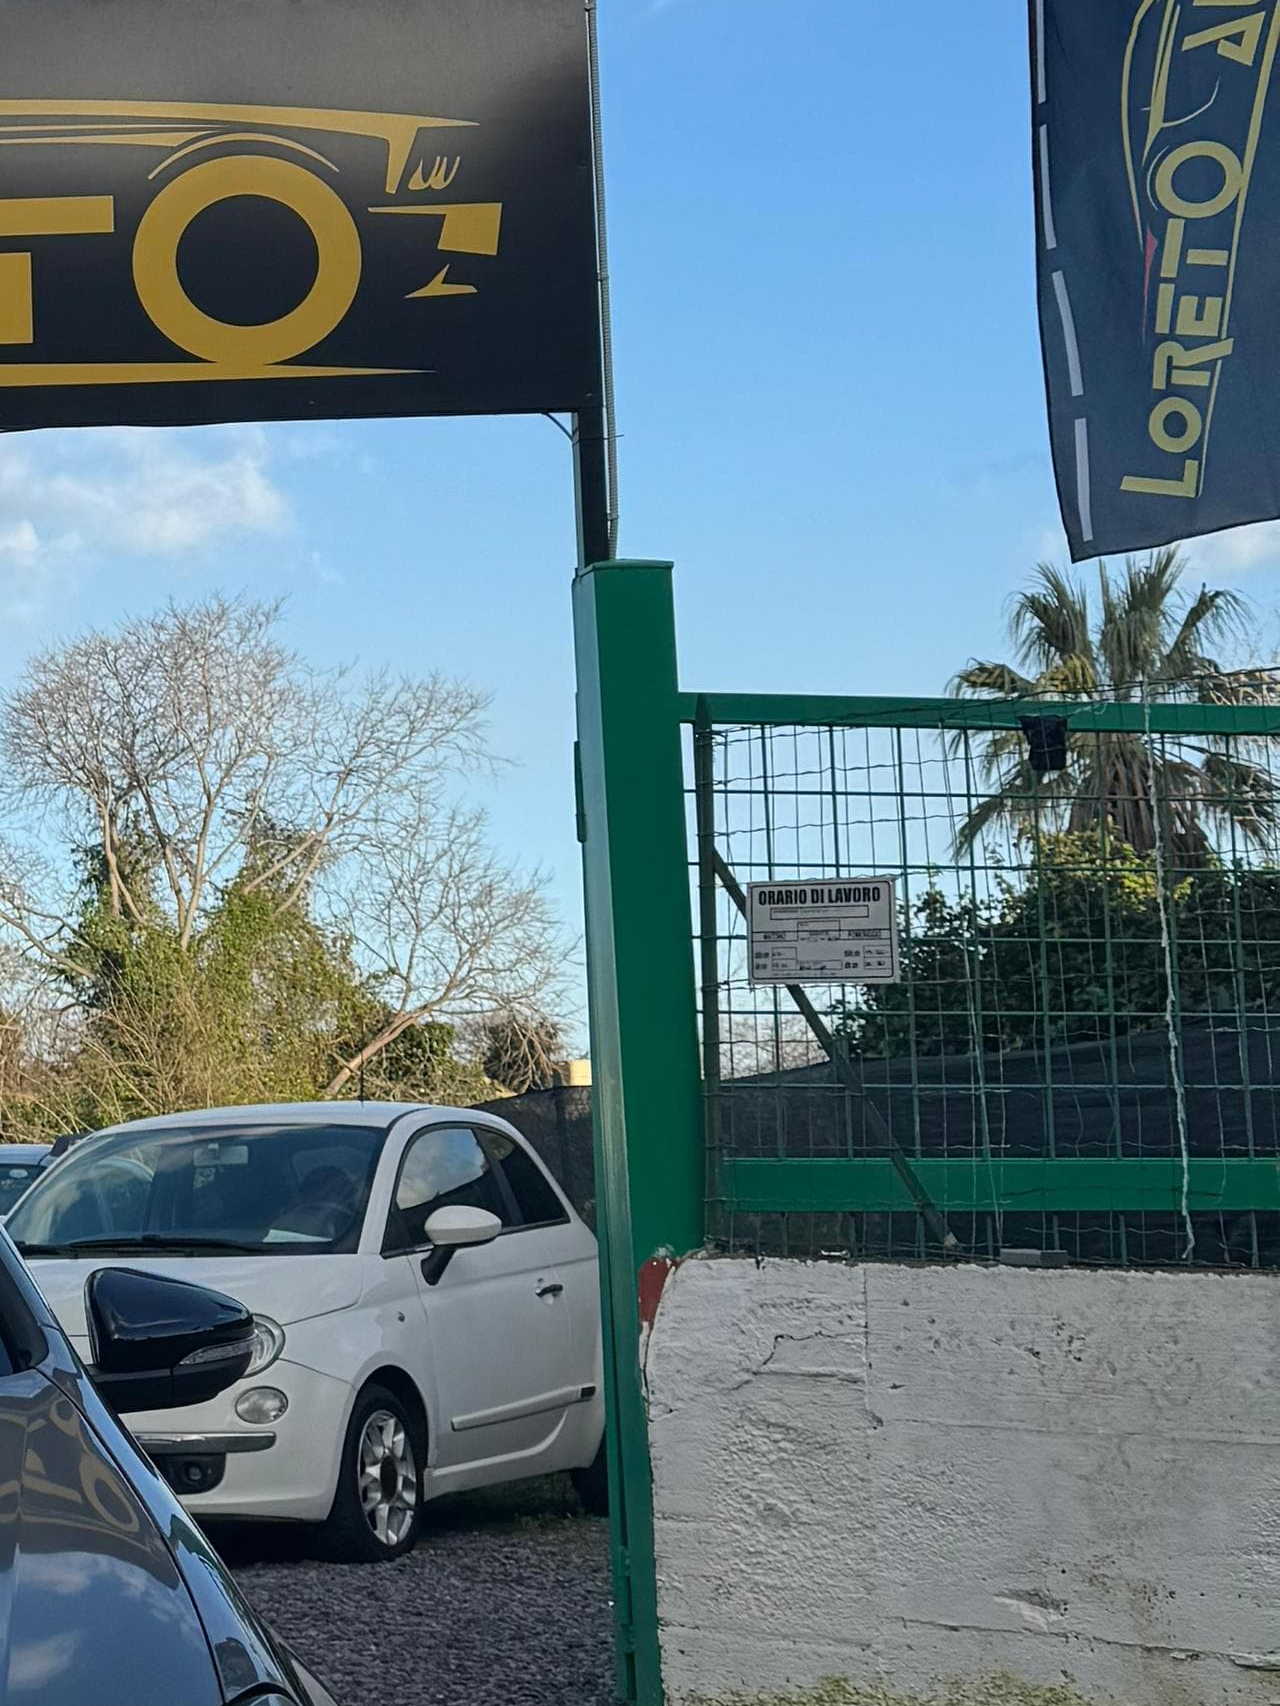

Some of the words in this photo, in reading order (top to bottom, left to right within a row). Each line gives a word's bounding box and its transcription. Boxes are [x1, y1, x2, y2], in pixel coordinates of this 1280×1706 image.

[1120, 140, 1243, 498] LORETO
[758, 889, 807, 906] ORARIO
[810, 888, 825, 904] DI
[827, 886, 881, 904] LAVORO
